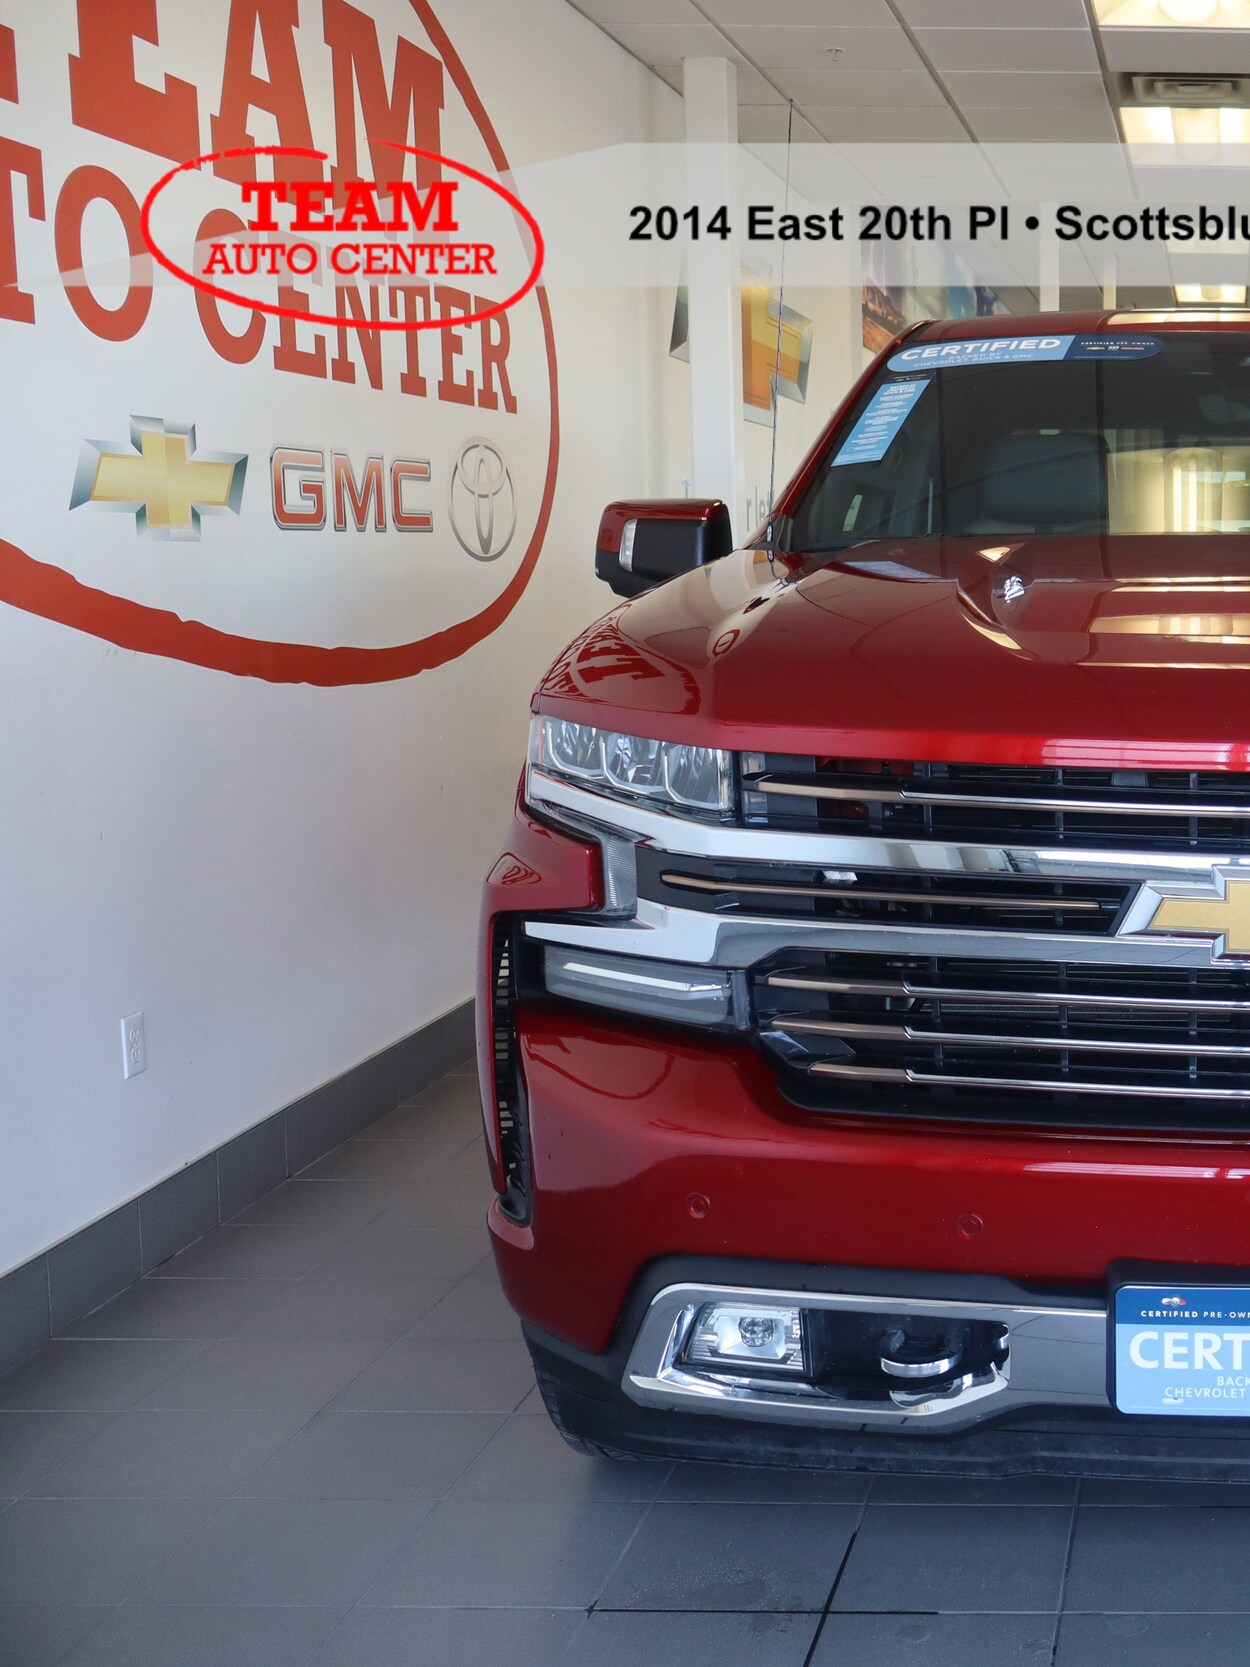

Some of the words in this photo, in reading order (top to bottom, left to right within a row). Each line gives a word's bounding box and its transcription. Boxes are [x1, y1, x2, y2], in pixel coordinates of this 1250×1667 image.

[195, 208, 517, 414] CENTER
[901, 339, 1062, 361] CERTIFIED
[949, 352, 987, 360] BACKED
[270, 445, 434, 533] GMC
[1140, 1309, 1199, 1318] CERTIFIED
[1164, 1386, 1246, 1399] CHEVROLET
